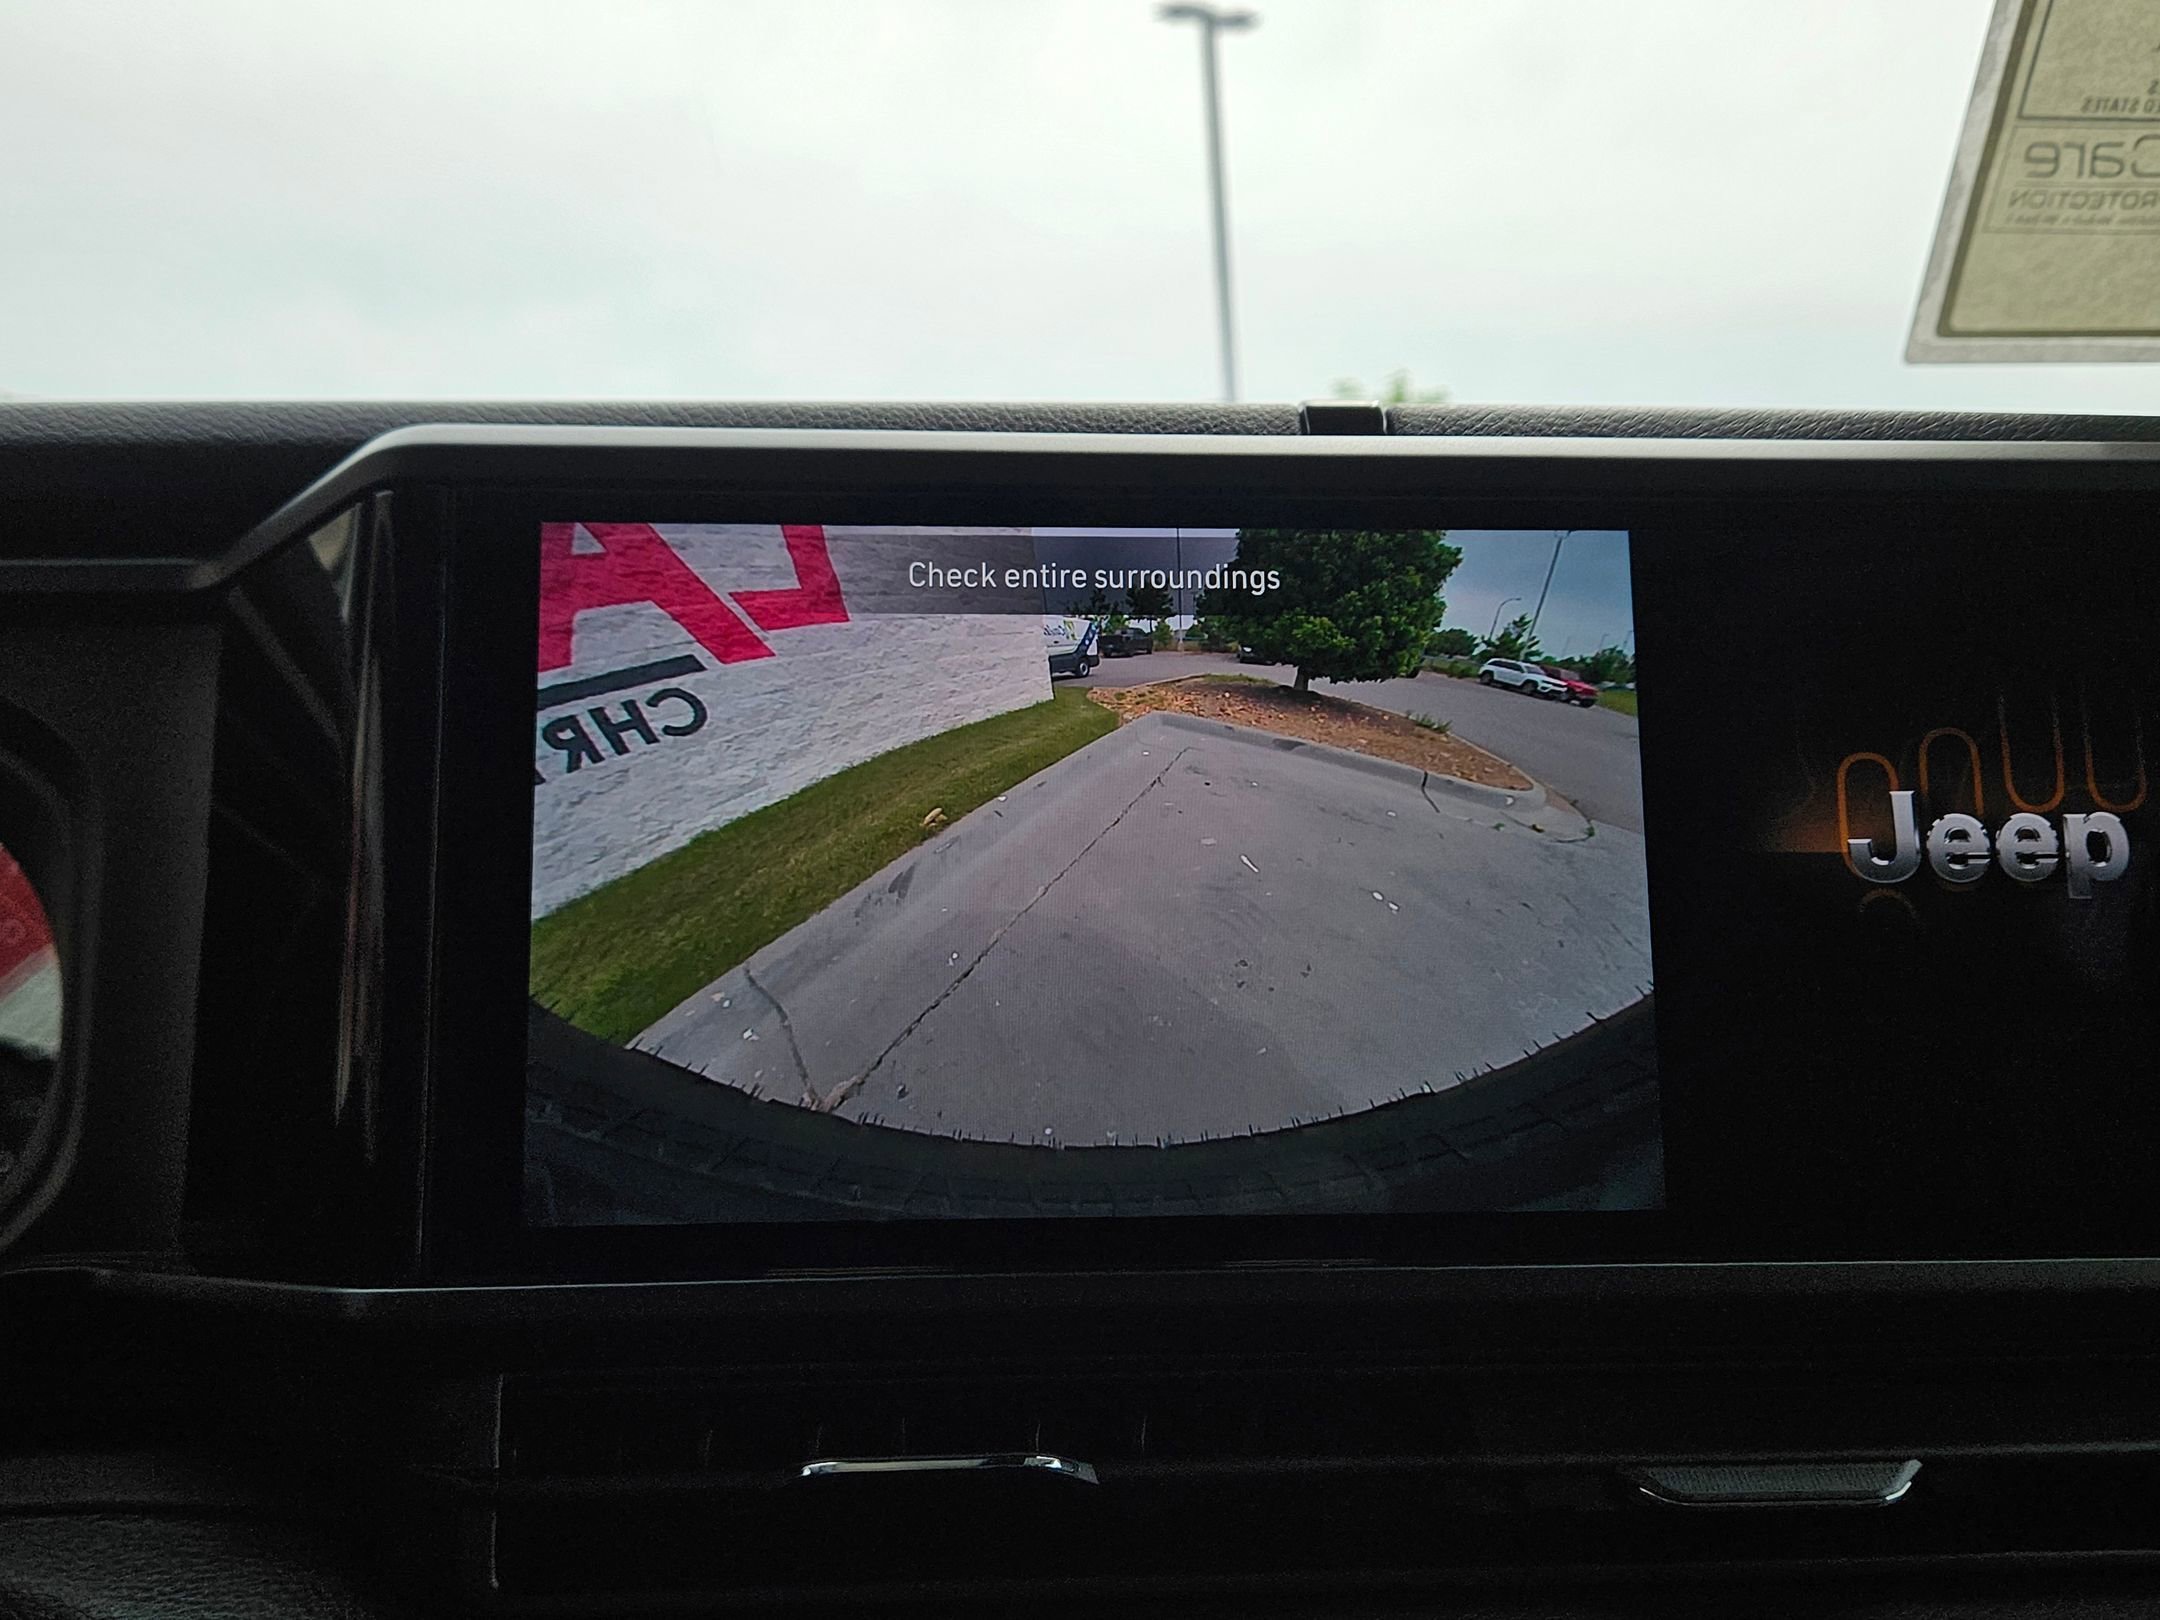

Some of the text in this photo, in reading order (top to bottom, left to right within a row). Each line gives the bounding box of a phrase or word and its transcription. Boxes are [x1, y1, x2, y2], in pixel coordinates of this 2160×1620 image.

[908, 561, 1281, 596] Check entire surroundings
[1847, 789, 2131, 899] Jeep
